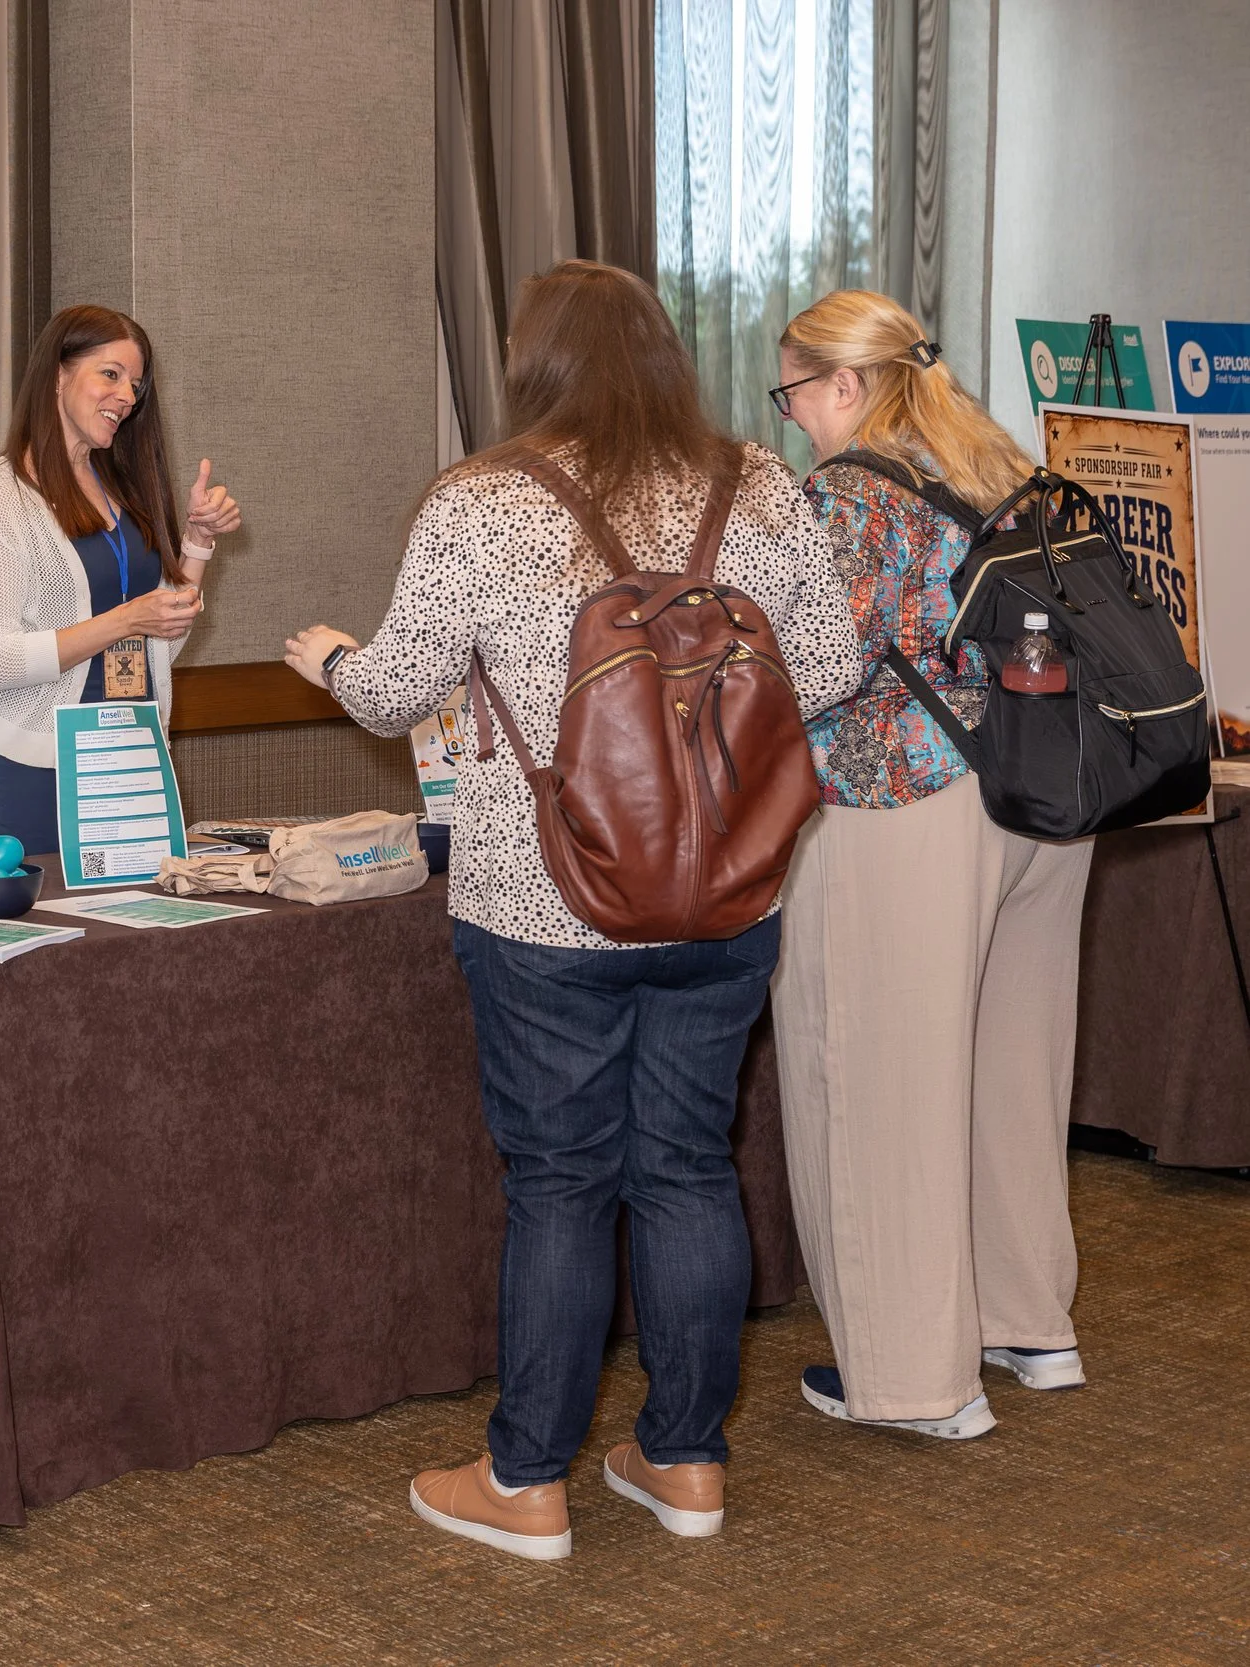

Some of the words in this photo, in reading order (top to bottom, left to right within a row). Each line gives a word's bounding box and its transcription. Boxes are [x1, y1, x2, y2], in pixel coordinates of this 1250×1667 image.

[1058, 356, 1096, 372] DISCOER
[1213, 355, 1250, 371] EXPLOR
[1198, 428, 1219, 439] Where
[1221, 427, 1240, 439] could
[1241, 430, 1250, 441] yo
[1075, 457, 1138, 476] SPONSORSHIP
[1141, 463, 1162, 479] FAIR
[1125, 551, 1187, 629] ASS
[100, 710, 122, 719] Ansell
[335, 846, 381, 868] Ansell
[380, 841, 410, 862] Well
